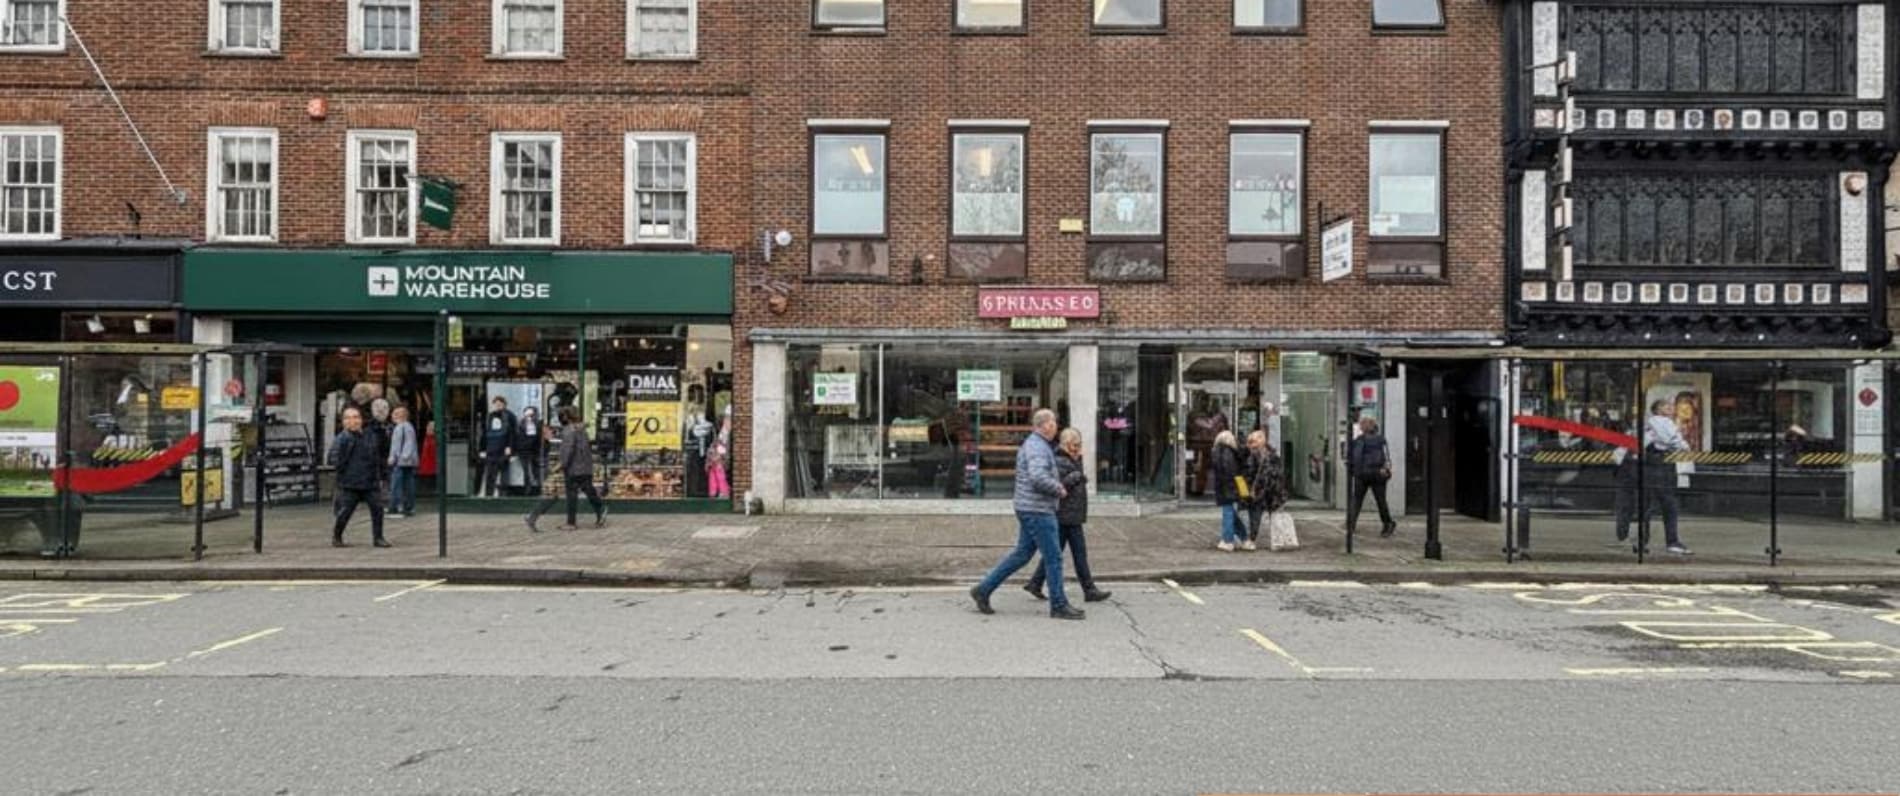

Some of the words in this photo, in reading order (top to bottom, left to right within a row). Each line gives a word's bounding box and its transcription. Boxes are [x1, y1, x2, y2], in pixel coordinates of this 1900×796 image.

[3, 270, 57, 290] CST
[404, 265, 525, 281] MOUNTAIN
[404, 282, 551, 299] WAREHOUSE
